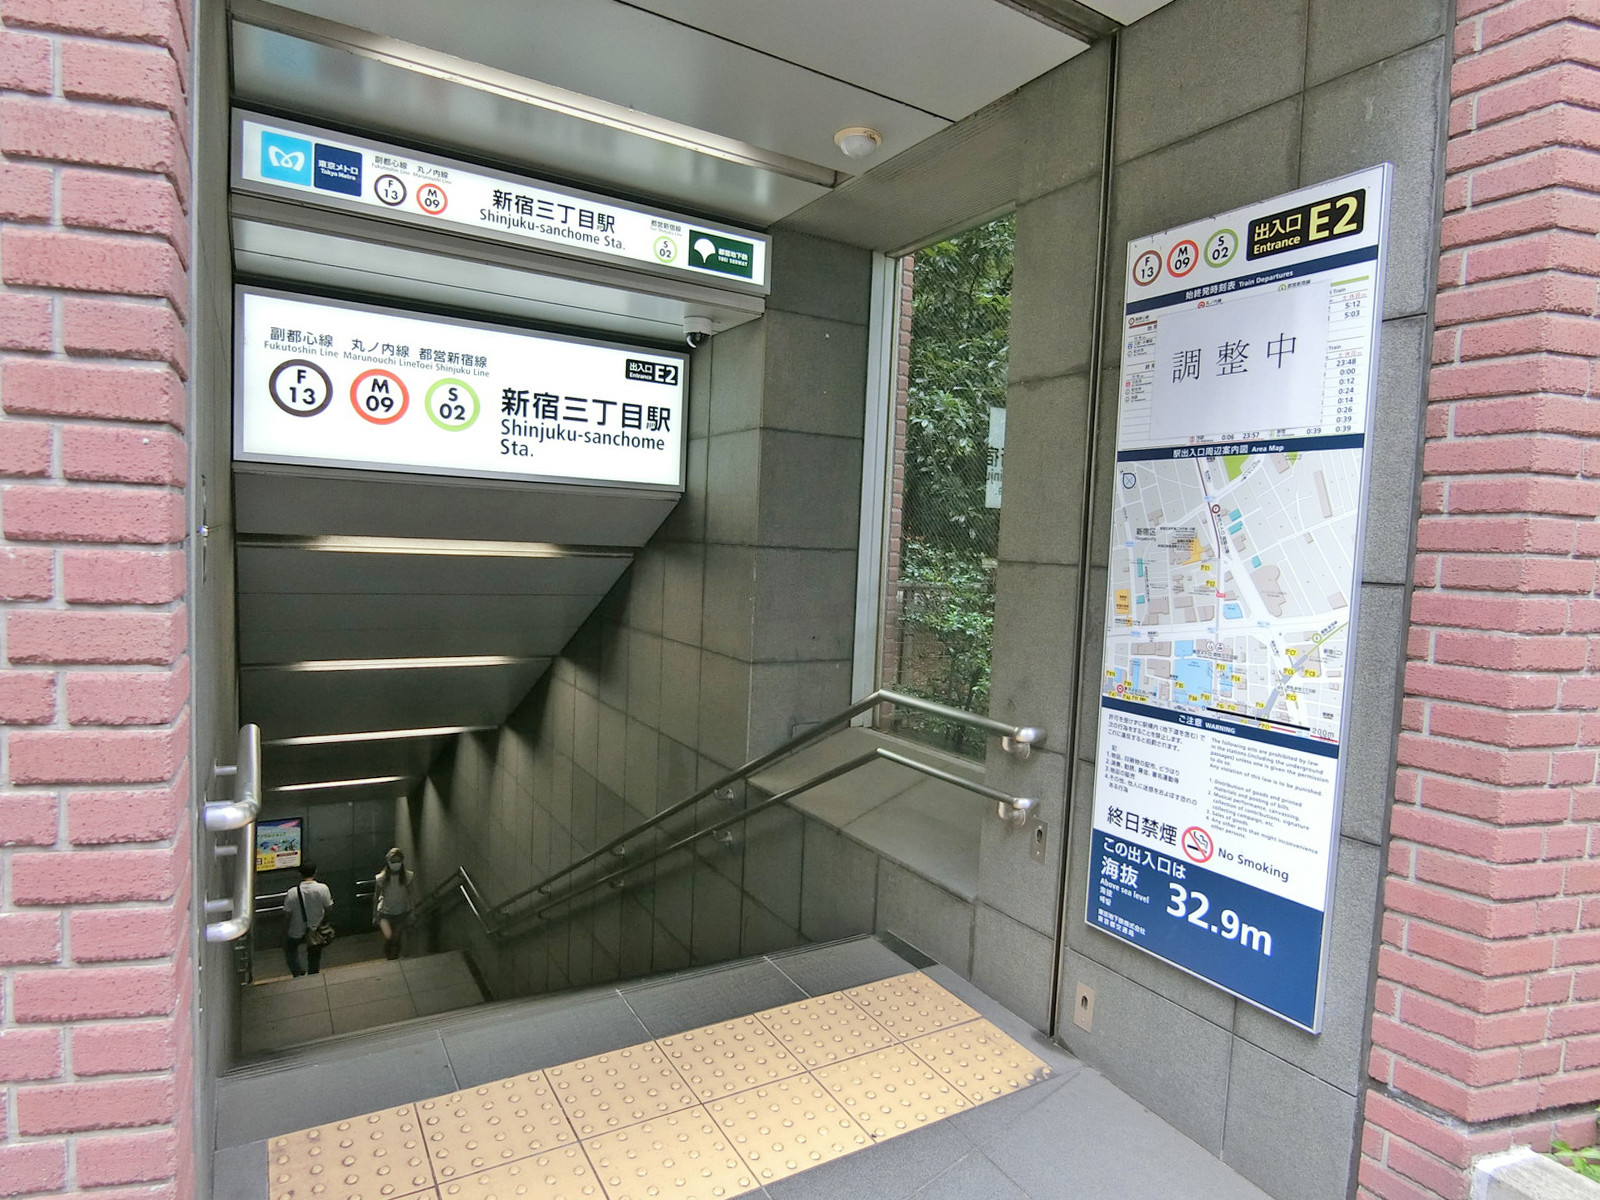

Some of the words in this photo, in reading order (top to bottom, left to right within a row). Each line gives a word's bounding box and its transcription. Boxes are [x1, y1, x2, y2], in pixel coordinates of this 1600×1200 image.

[318, 159, 359, 175] 東京メトロ
[375, 155, 407, 169] 副都心線
[320, 167, 338, 177] Tokyo
[338, 171, 356, 181] Metro
[417, 165, 448, 179] 丸ノ内線
[388, 179, 393, 188] F
[384, 188, 398, 200] 13
[427, 189, 437, 198] M
[424, 197, 440, 208] 09
[492, 189, 615, 234] 新宿三丁目駅
[1308, 196, 1358, 241] E2
[480, 208, 600, 245] Shinjuku-sanchome
[604, 235, 625, 250] Sta.
[651, 220, 681, 232] 都営新宿線
[1254, 213, 1302, 242] 出入口
[663, 240, 668, 248] S
[1218, 235, 1224, 247] S
[1253, 236, 1301, 254] Entrance
[659, 248, 671, 258] 02
[1176, 246, 1188, 258] M
[1210, 246, 1230, 263] 02
[1145, 256, 1150, 266] F
[1172, 256, 1191, 273] 09
[1141, 266, 1154, 279] 13
[1185, 280, 1236, 300] 始終発時刻表
[1238, 279, 1255, 287] Train
[1256, 270, 1293, 284] Departures
[1345, 300, 1361, 309] 5:12
[1344, 310, 1360, 319] 5:03
[270, 326, 333, 348] 副都心線
[264, 340, 317, 355] Fukutoshin
[320, 348, 339, 358] Line
[351, 338, 409, 358] 丸ノ内線
[343, 351, 396, 365] Marunouchi
[399, 358, 417, 368] Line
[419, 347, 487, 368] 都営新宿線
[1172, 332, 1296, 384] 調整中
[1336, 358, 1356, 367] 23:48
[416, 360, 433, 370] Toei
[435, 363, 471, 375] Shinjuku
[473, 368, 490, 377] Line
[629, 362, 653, 374] 出入口
[629, 371, 652, 380] Entrance
[654, 364, 676, 384] E2
[1339, 367, 1356, 376] 0:00
[297, 369, 306, 384] F
[1338, 377, 1355, 385] 0:12
[371, 378, 389, 394] M
[1338, 387, 1354, 395] 0:24
[289, 386, 315, 405] 13
[448, 387, 458, 402] S
[1337, 396, 1353, 404] 0:14
[366, 395, 394, 412] 09
[501, 387, 671, 432] 新宿三丁目駅
[1336, 406, 1353, 414] 0:26
[439, 403, 465, 420] 02
[1336, 415, 1352, 423] 0:39
[501, 418, 665, 450] Shinjuku-sanchome
[1242, 431, 1260, 439] 23:57
[1306, 427, 1322, 435] 0:39
[500, 438, 533, 457] Sta.
[1173, 444, 1249, 458] 駅出入口周辺案内図
[1178, 714, 1203, 727] ご注意
[1205, 722, 1236, 734] WARNING
[1312, 727, 1335, 738] 200m
[1221, 739, 1246, 751] following
[1268, 751, 1298, 762] prohibited
[1220, 767, 1243, 775] violation
[1235, 757, 1252, 765] unless
[1297, 772, 1329, 783] permission
[1285, 763, 1324, 775] underground
[1213, 792, 1232, 801] Musical
[1248, 796, 1269, 806] posting
[1252, 790, 1269, 798] goods
[1281, 798, 1302, 807] printed
[1212, 810, 1225, 819] Sales
[1107, 805, 1177, 846] 終日禁煙
[1282, 819, 1309, 830] signature
[1211, 817, 1221, 825] Any
[1260, 833, 1277, 841] might
[1278, 838, 1318, 854] inconvenience
[1103, 837, 1186, 879] この出入口は
[1218, 847, 1234, 861] No
[1237, 854, 1289, 883] Smoking
[1101, 855, 1139, 889] 海抜
[1100, 877, 1120, 891] Above
[1121, 887, 1132, 897] sea
[1133, 890, 1150, 904] level
[1166, 882, 1272, 956] 32.9m
